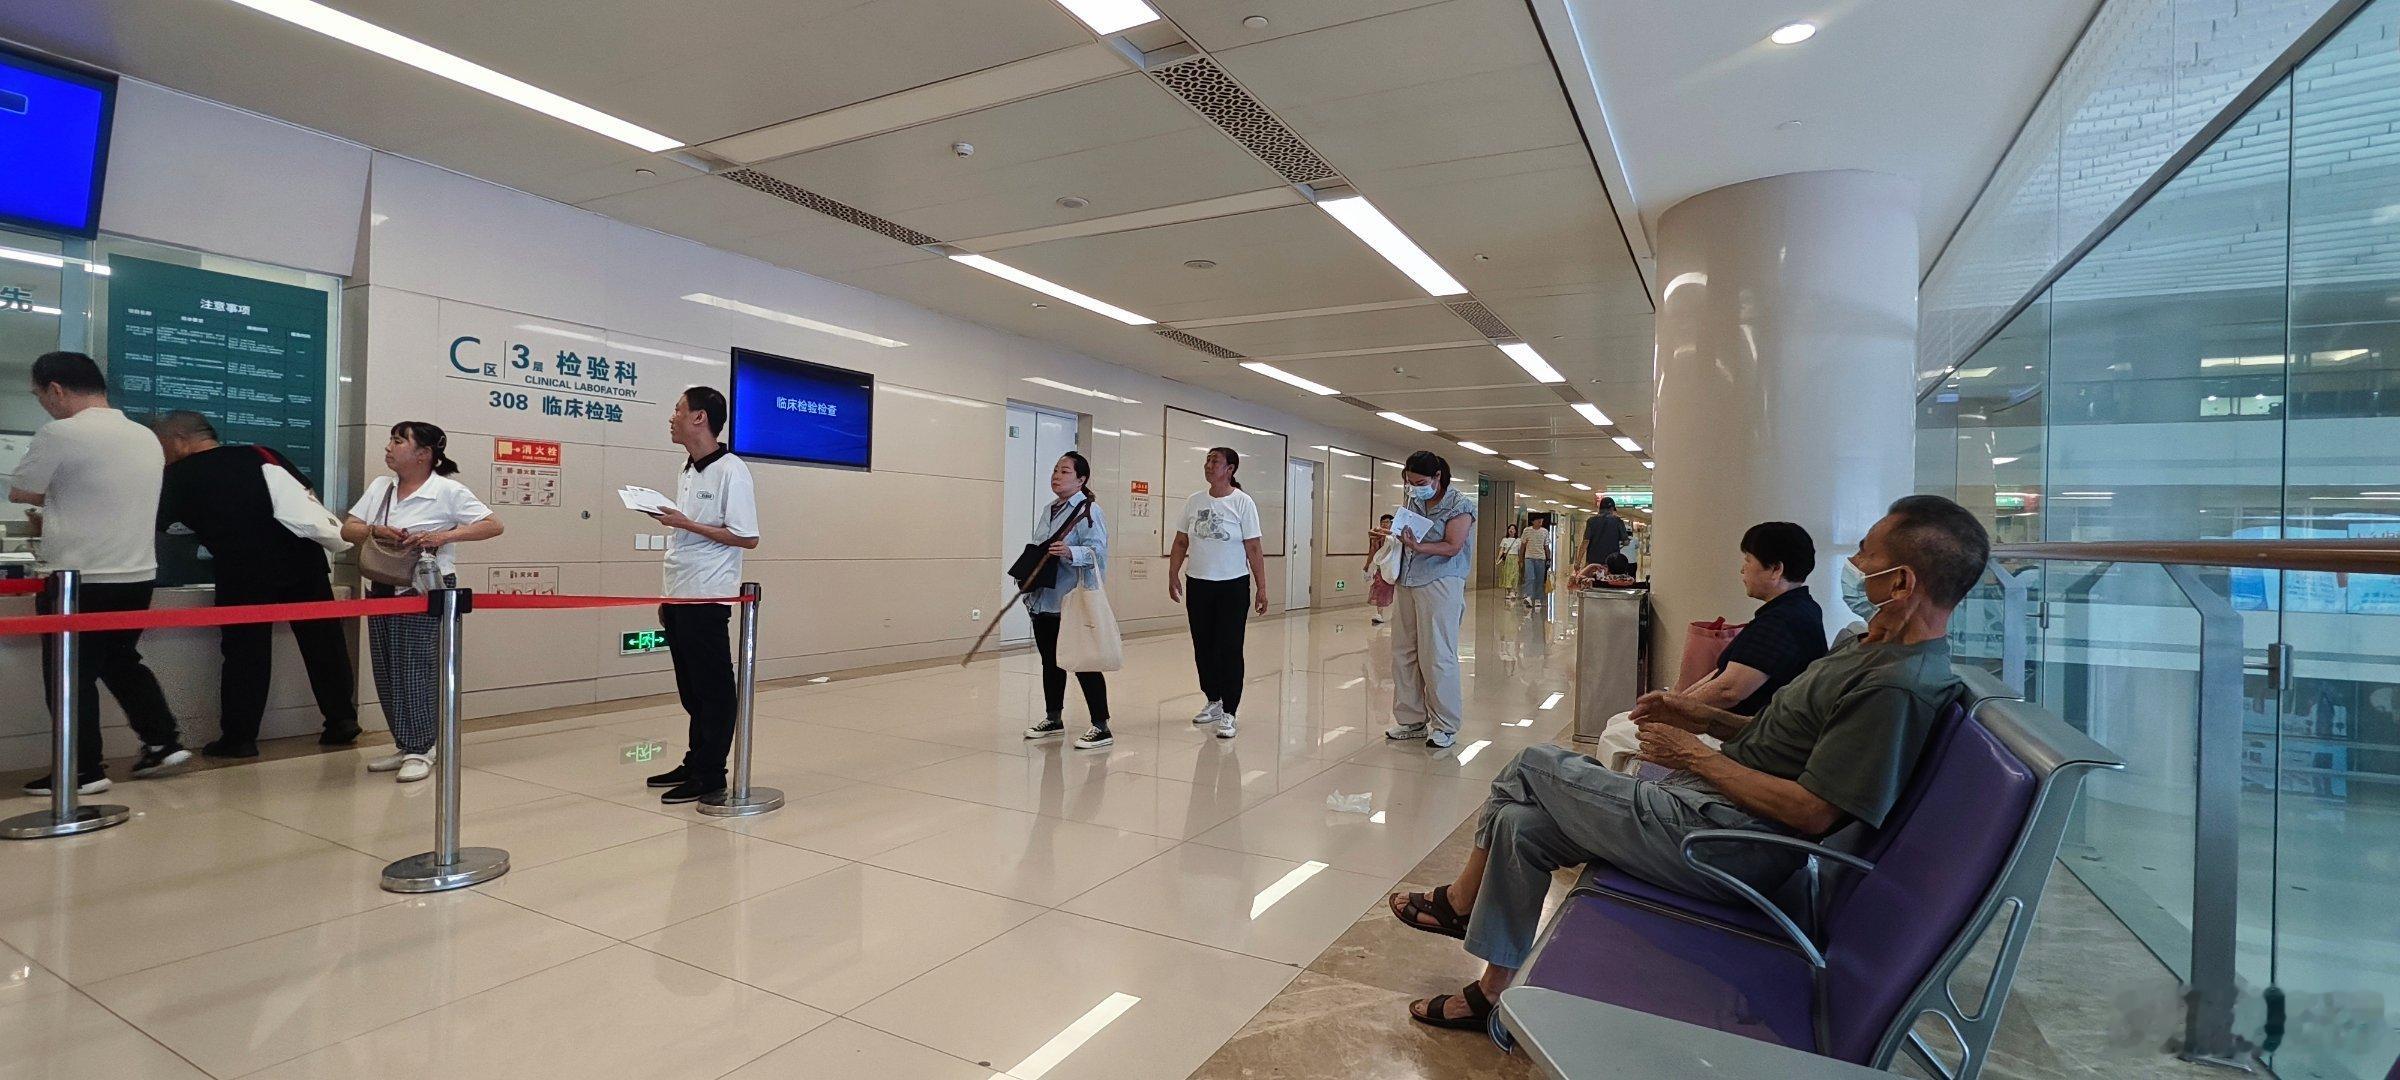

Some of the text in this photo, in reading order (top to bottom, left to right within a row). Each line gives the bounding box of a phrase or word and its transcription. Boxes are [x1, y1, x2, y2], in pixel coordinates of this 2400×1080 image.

[200, 299, 250, 316] 注意事项
[556, 350, 638, 386] 检验科
[525, 375, 572, 389] CLINICAL
[489, 391, 623, 423] 308 临床检验
[776, 396, 837, 417] 临床检验检查
[521, 444, 558, 457] 消火栓
